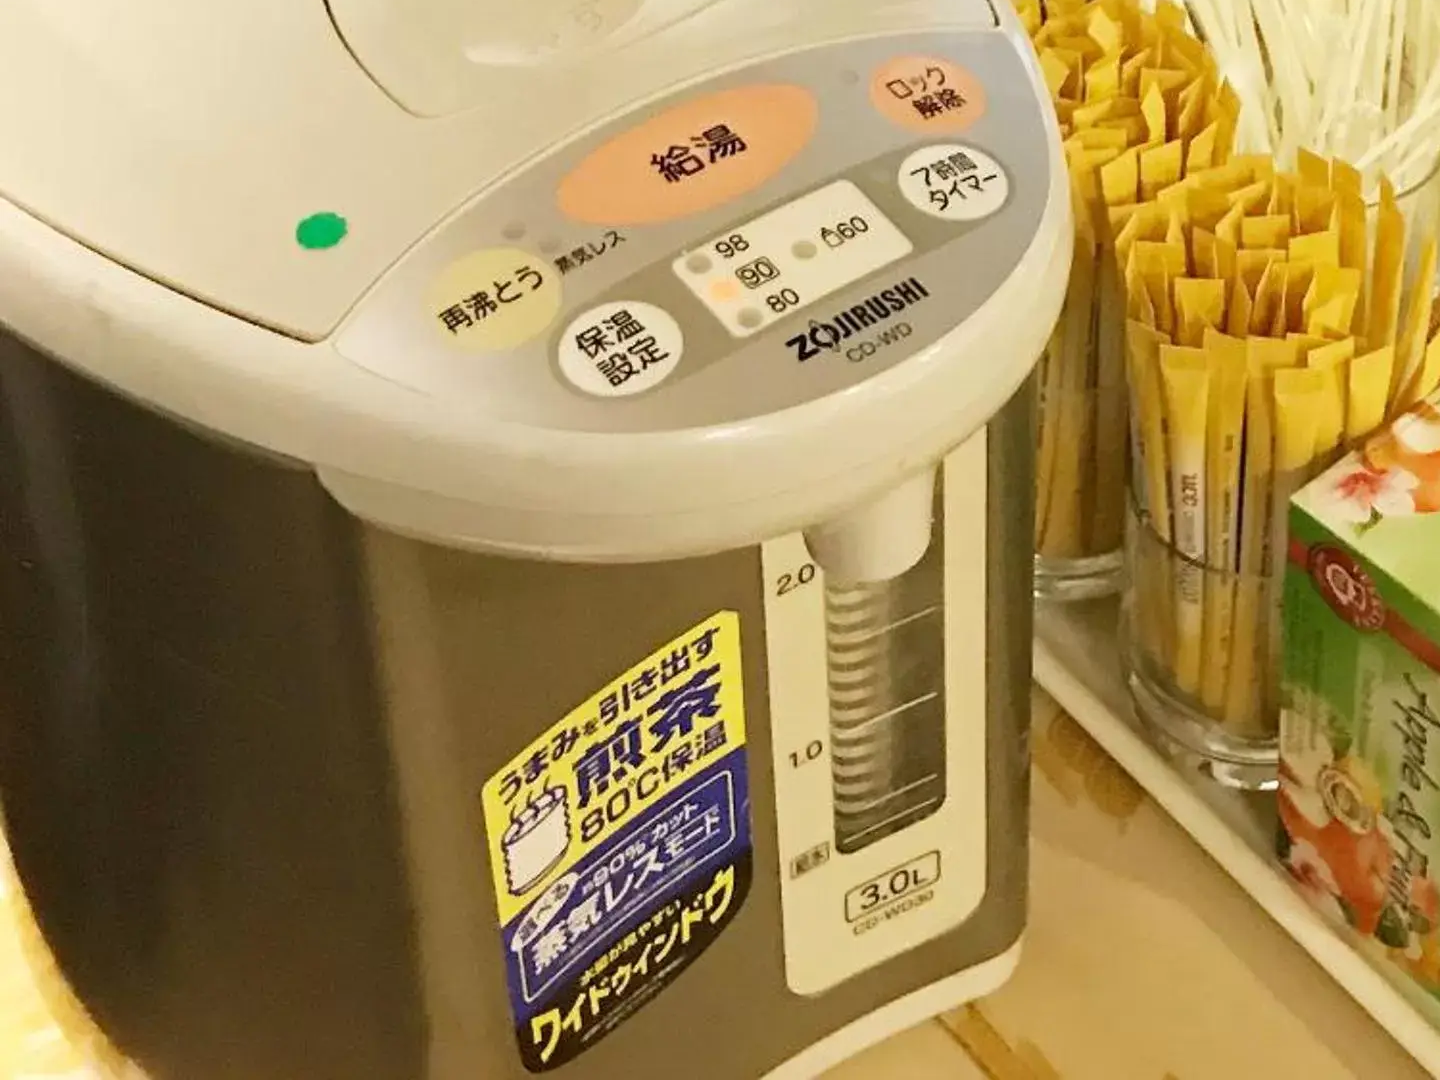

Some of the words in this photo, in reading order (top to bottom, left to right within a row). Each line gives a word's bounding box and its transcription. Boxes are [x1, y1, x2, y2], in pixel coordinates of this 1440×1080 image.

[886, 66, 946, 100] ロック
[912, 88, 967, 120] 解除
[650, 124, 748, 183] 給湯
[910, 151, 979, 188] 7時間
[929, 172, 999, 211] タイマー
[715, 233, 751, 259] 98
[836, 214, 870, 241] 60
[553, 230, 627, 275] 蒸気レス
[740, 260, 777, 286] 90
[437, 265, 544, 336] 再沸とう
[765, 288, 801, 313] 80
[785, 276, 931, 362] ZOJIRUSHI
[575, 309, 646, 360] 保温
[845, 321, 914, 364] CD-WD
[596, 335, 670, 388] 設定
[776, 563, 816, 597] 2.0
[498, 626, 721, 806] うまみを引き出す
[571, 662, 723, 810] 煎茶
[789, 739, 823, 769] 1.0
[860, 869, 928, 910] 3.0L
